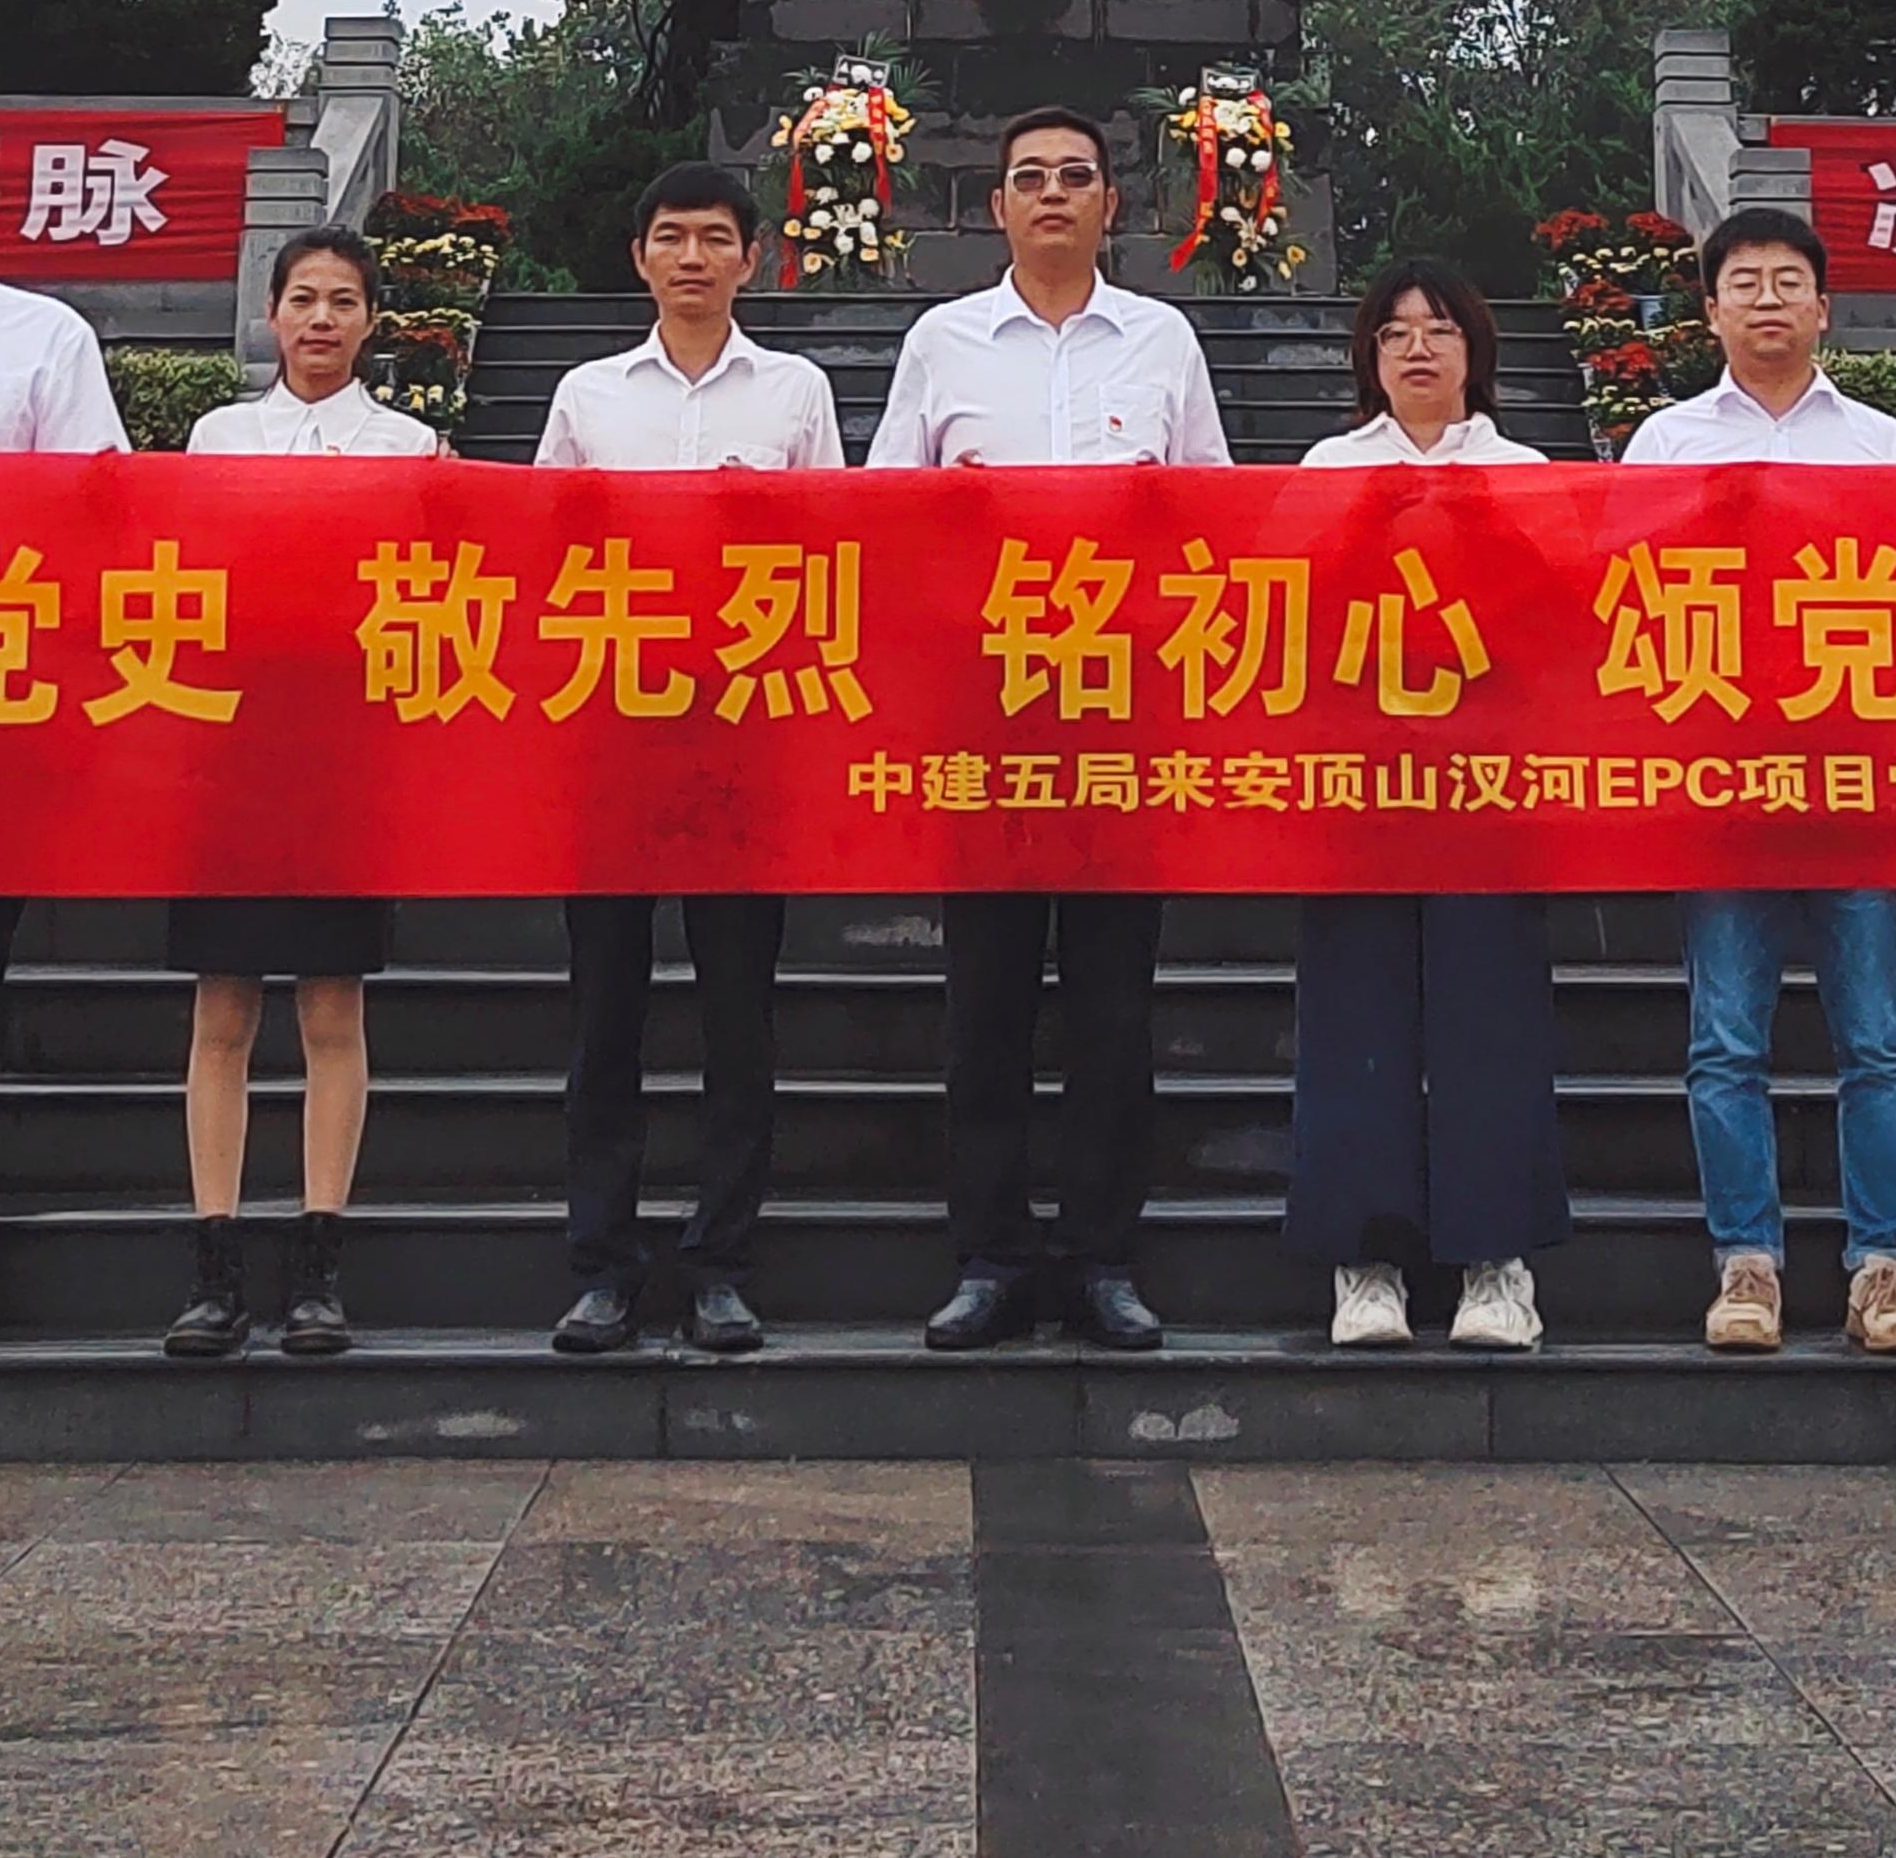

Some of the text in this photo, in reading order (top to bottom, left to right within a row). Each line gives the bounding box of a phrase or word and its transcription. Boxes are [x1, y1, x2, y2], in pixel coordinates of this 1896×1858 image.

[354, 537, 872, 724] 敬先烈
[980, 536, 1490, 720] 铭初心
